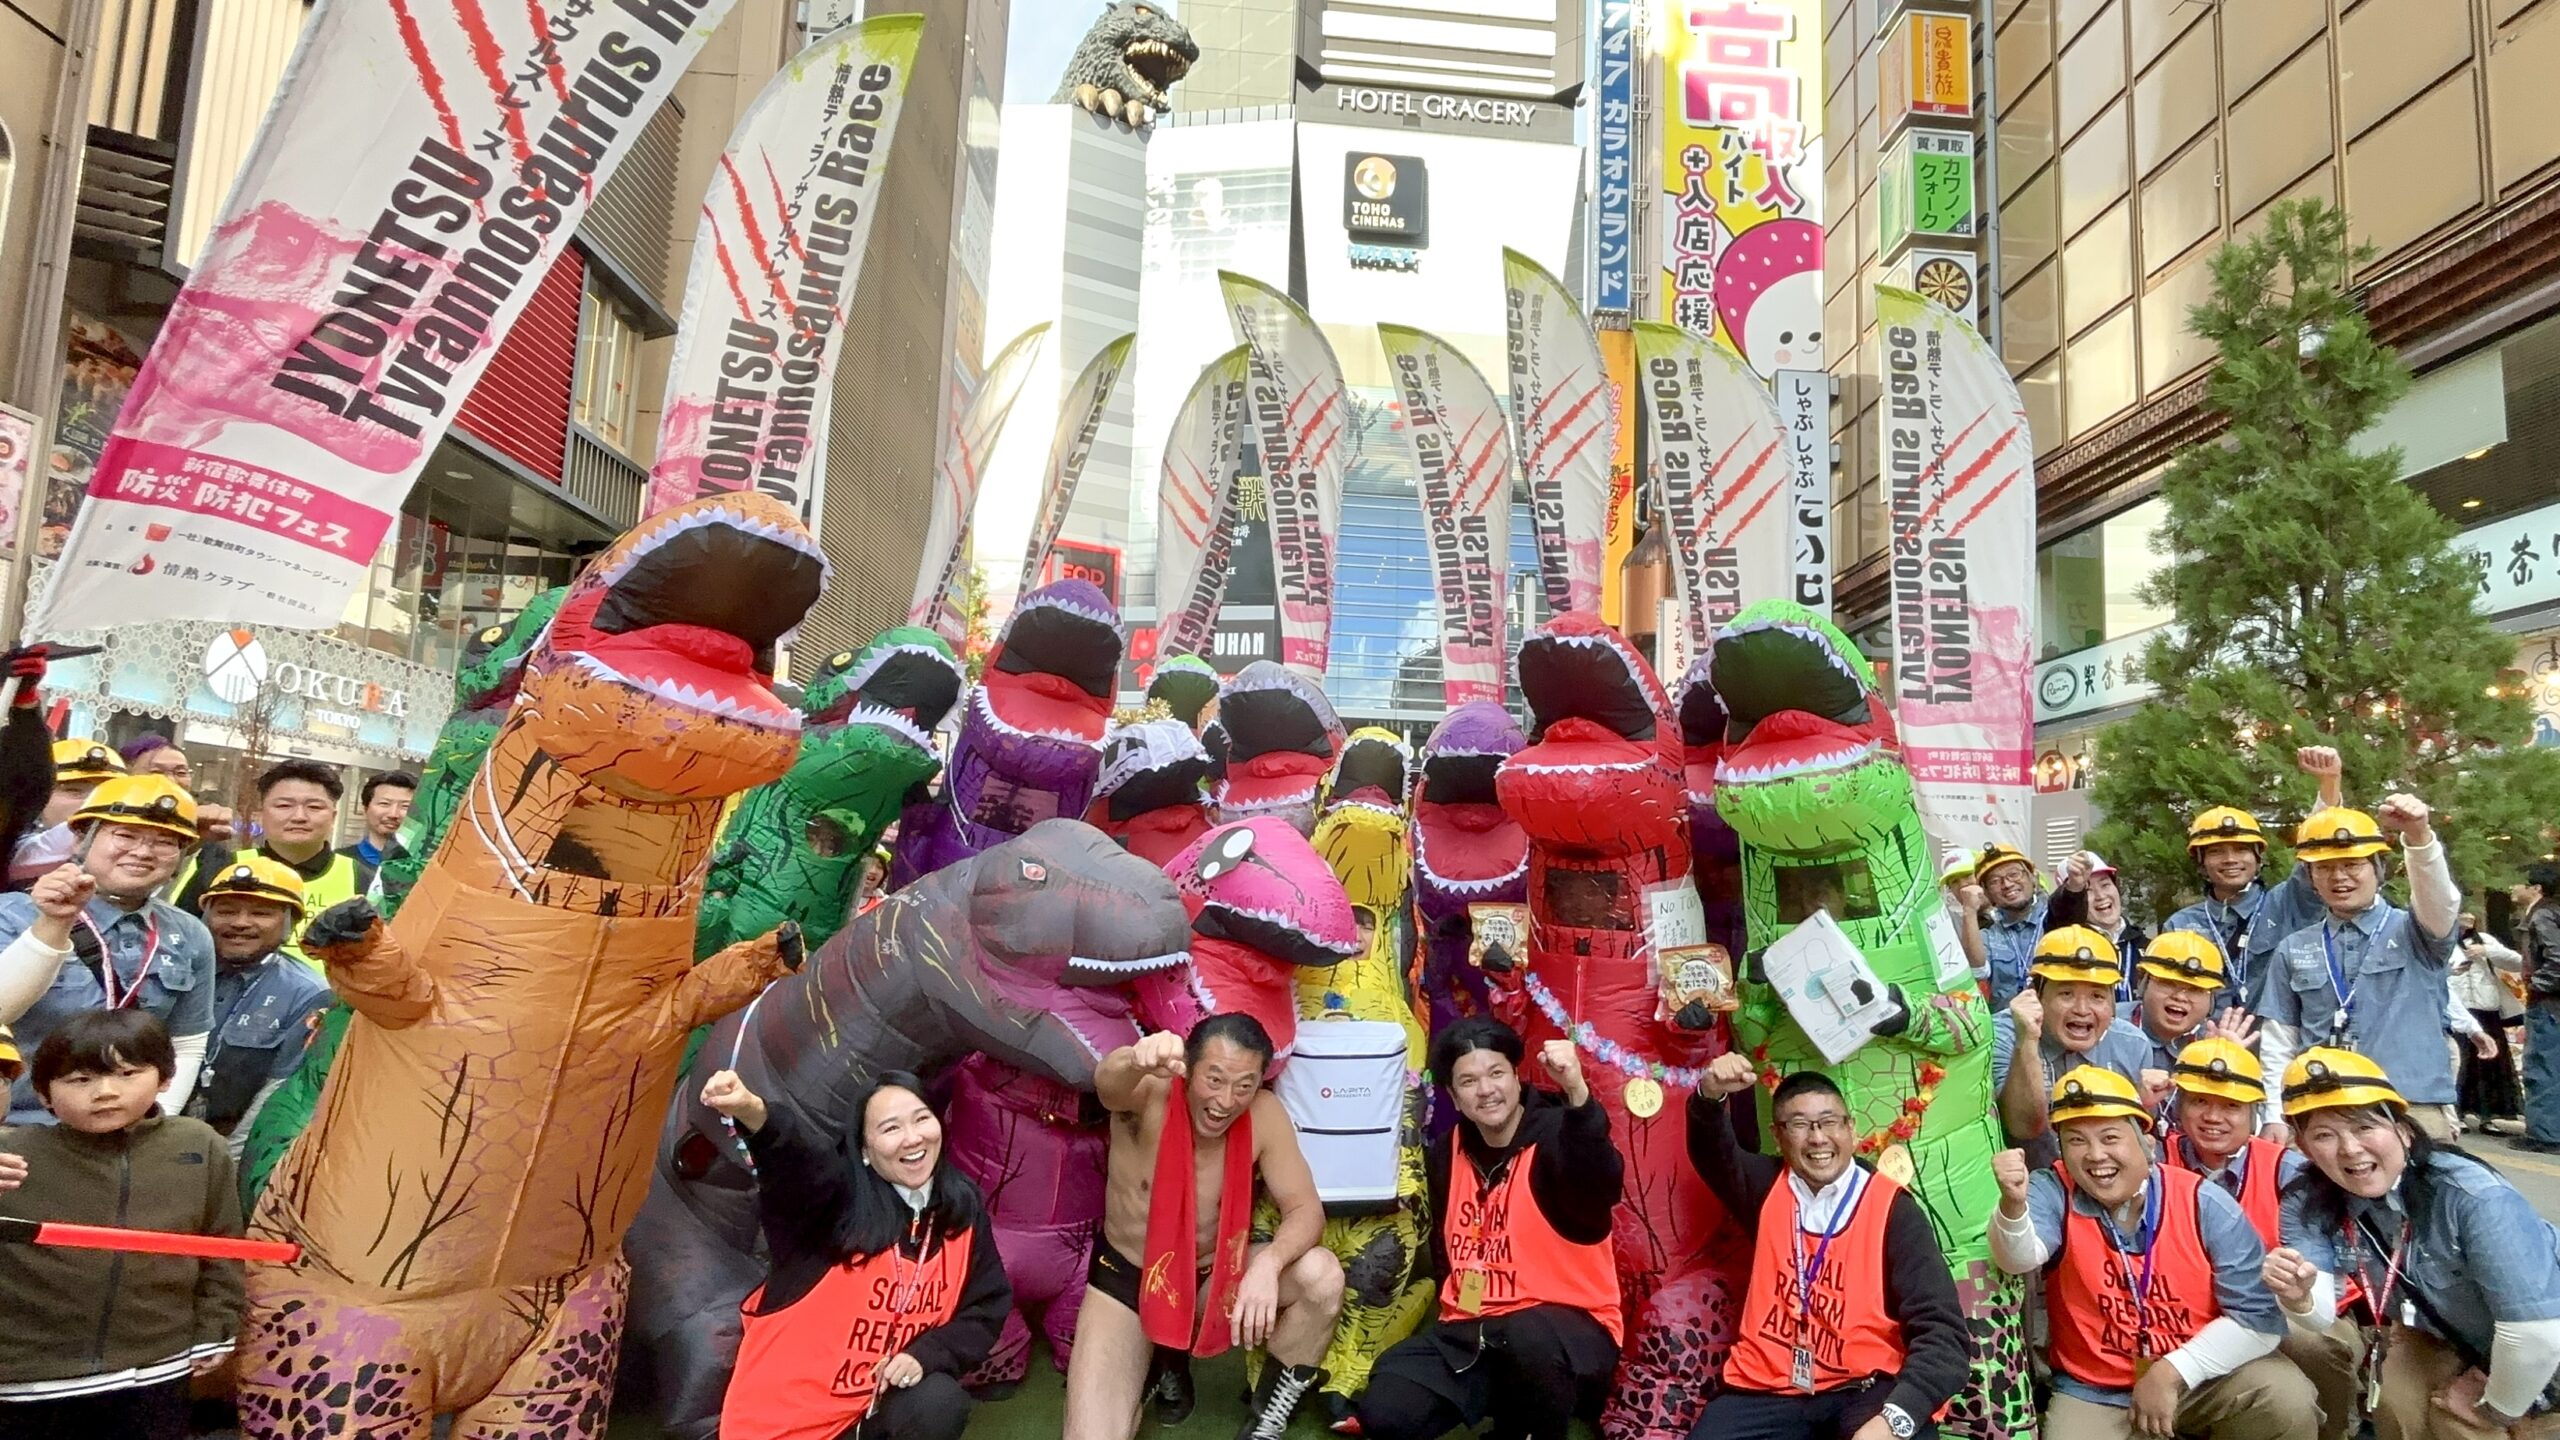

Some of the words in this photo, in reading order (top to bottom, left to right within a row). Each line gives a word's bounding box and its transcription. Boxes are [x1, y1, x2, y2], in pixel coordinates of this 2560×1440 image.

[817, 63, 892, 188] Race
[1337, 88, 1416, 115] HOTEL
[1422, 95, 1535, 126] GRACERY
[759, 62, 853, 321] 情熱ティラノサウルスレース
[1352, 202, 1391, 216] TOHO
[1600, 99, 1629, 297] カラオケランド
[339, 31, 662, 438] Tyrannosaurus
[1351, 214, 1405, 229] CINEMAS
[1956, 223, 1971, 233] 5F
[272, 137, 500, 416] JYONETSU
[754, 194, 859, 508] yrannosaurus
[696, 317, 779, 501] YONETSU
[1794, 378, 1815, 489] しゃぶしゃぶ
[182, 456, 315, 504] 新宿歌舞伎町
[162, 561, 256, 591] 情熱クラブ
[275, 661, 405, 718] OKURA
[316, 708, 361, 729] TOKYO
[1793, 1348, 1810, 1369] FRA
